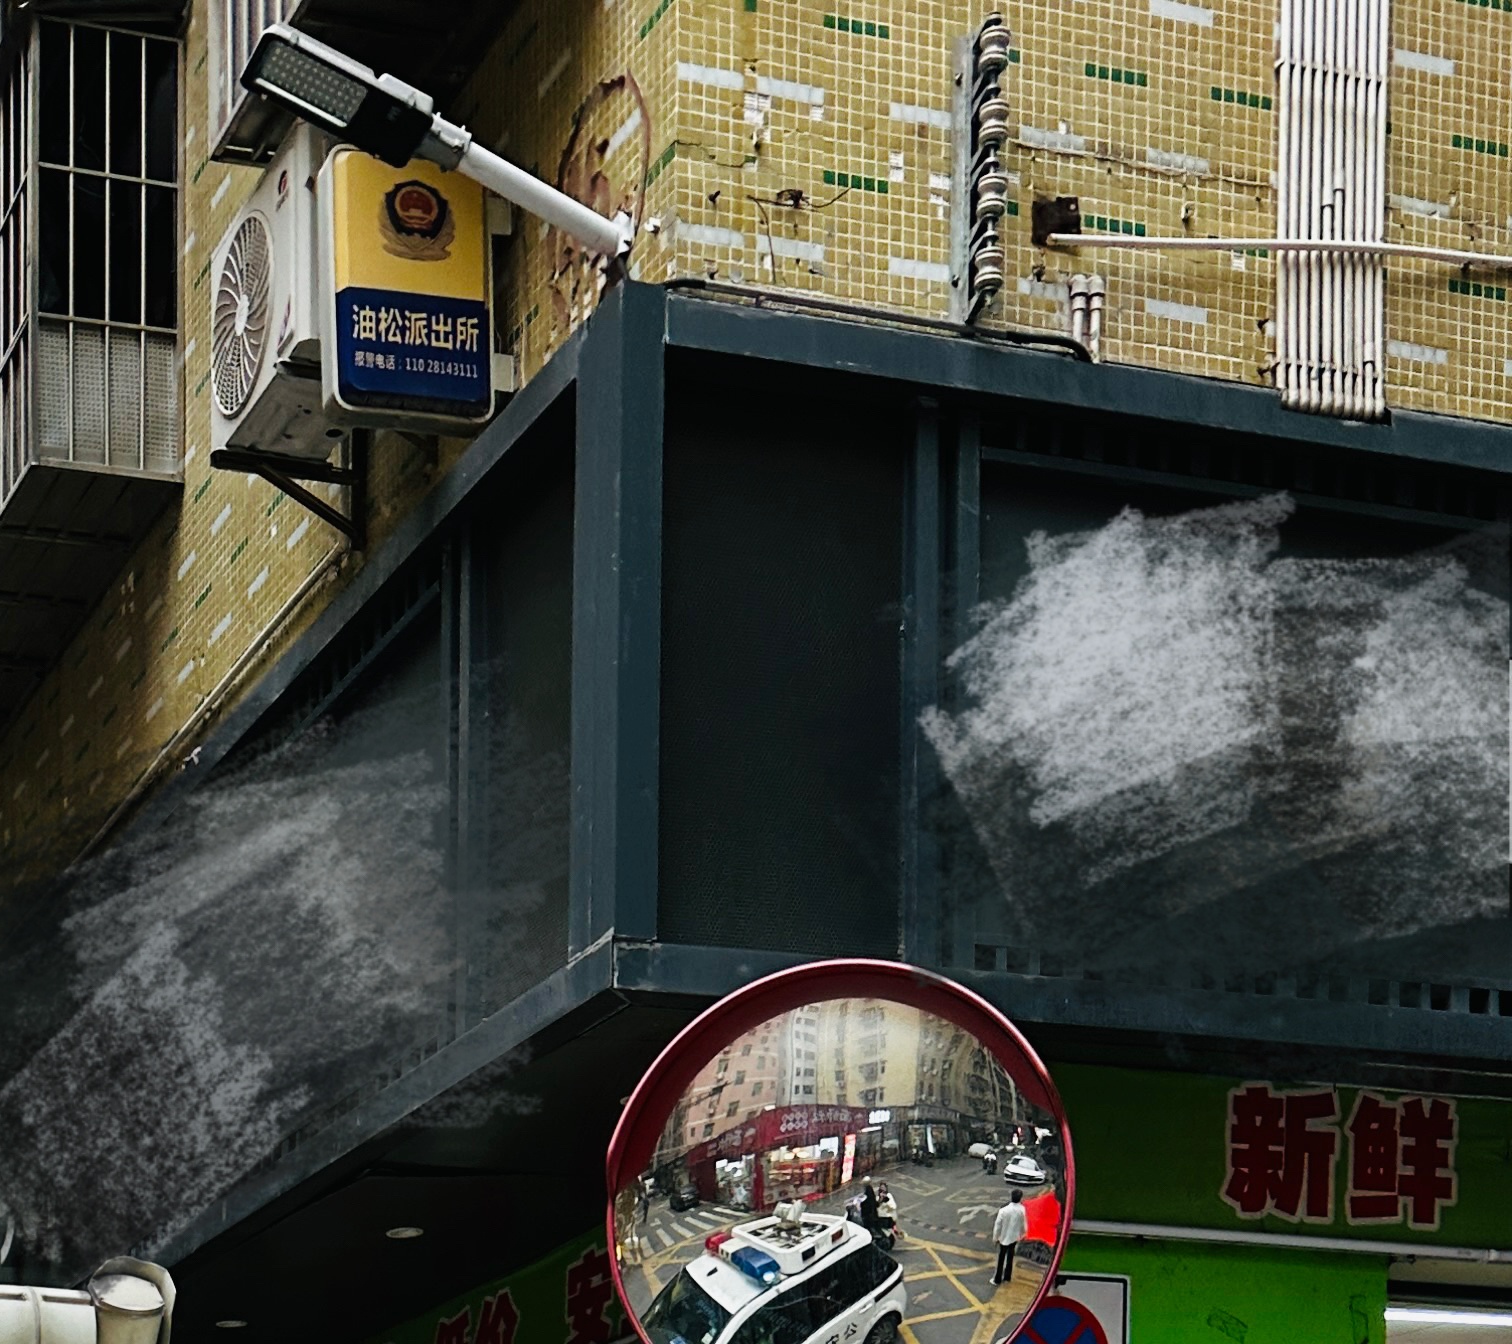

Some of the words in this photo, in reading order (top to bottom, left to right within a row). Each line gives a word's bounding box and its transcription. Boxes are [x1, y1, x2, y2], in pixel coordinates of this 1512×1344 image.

[352, 304, 479, 352] 油松派出所
[405, 357, 425, 372] 110
[1222, 1082, 1458, 1230] 新鲜
